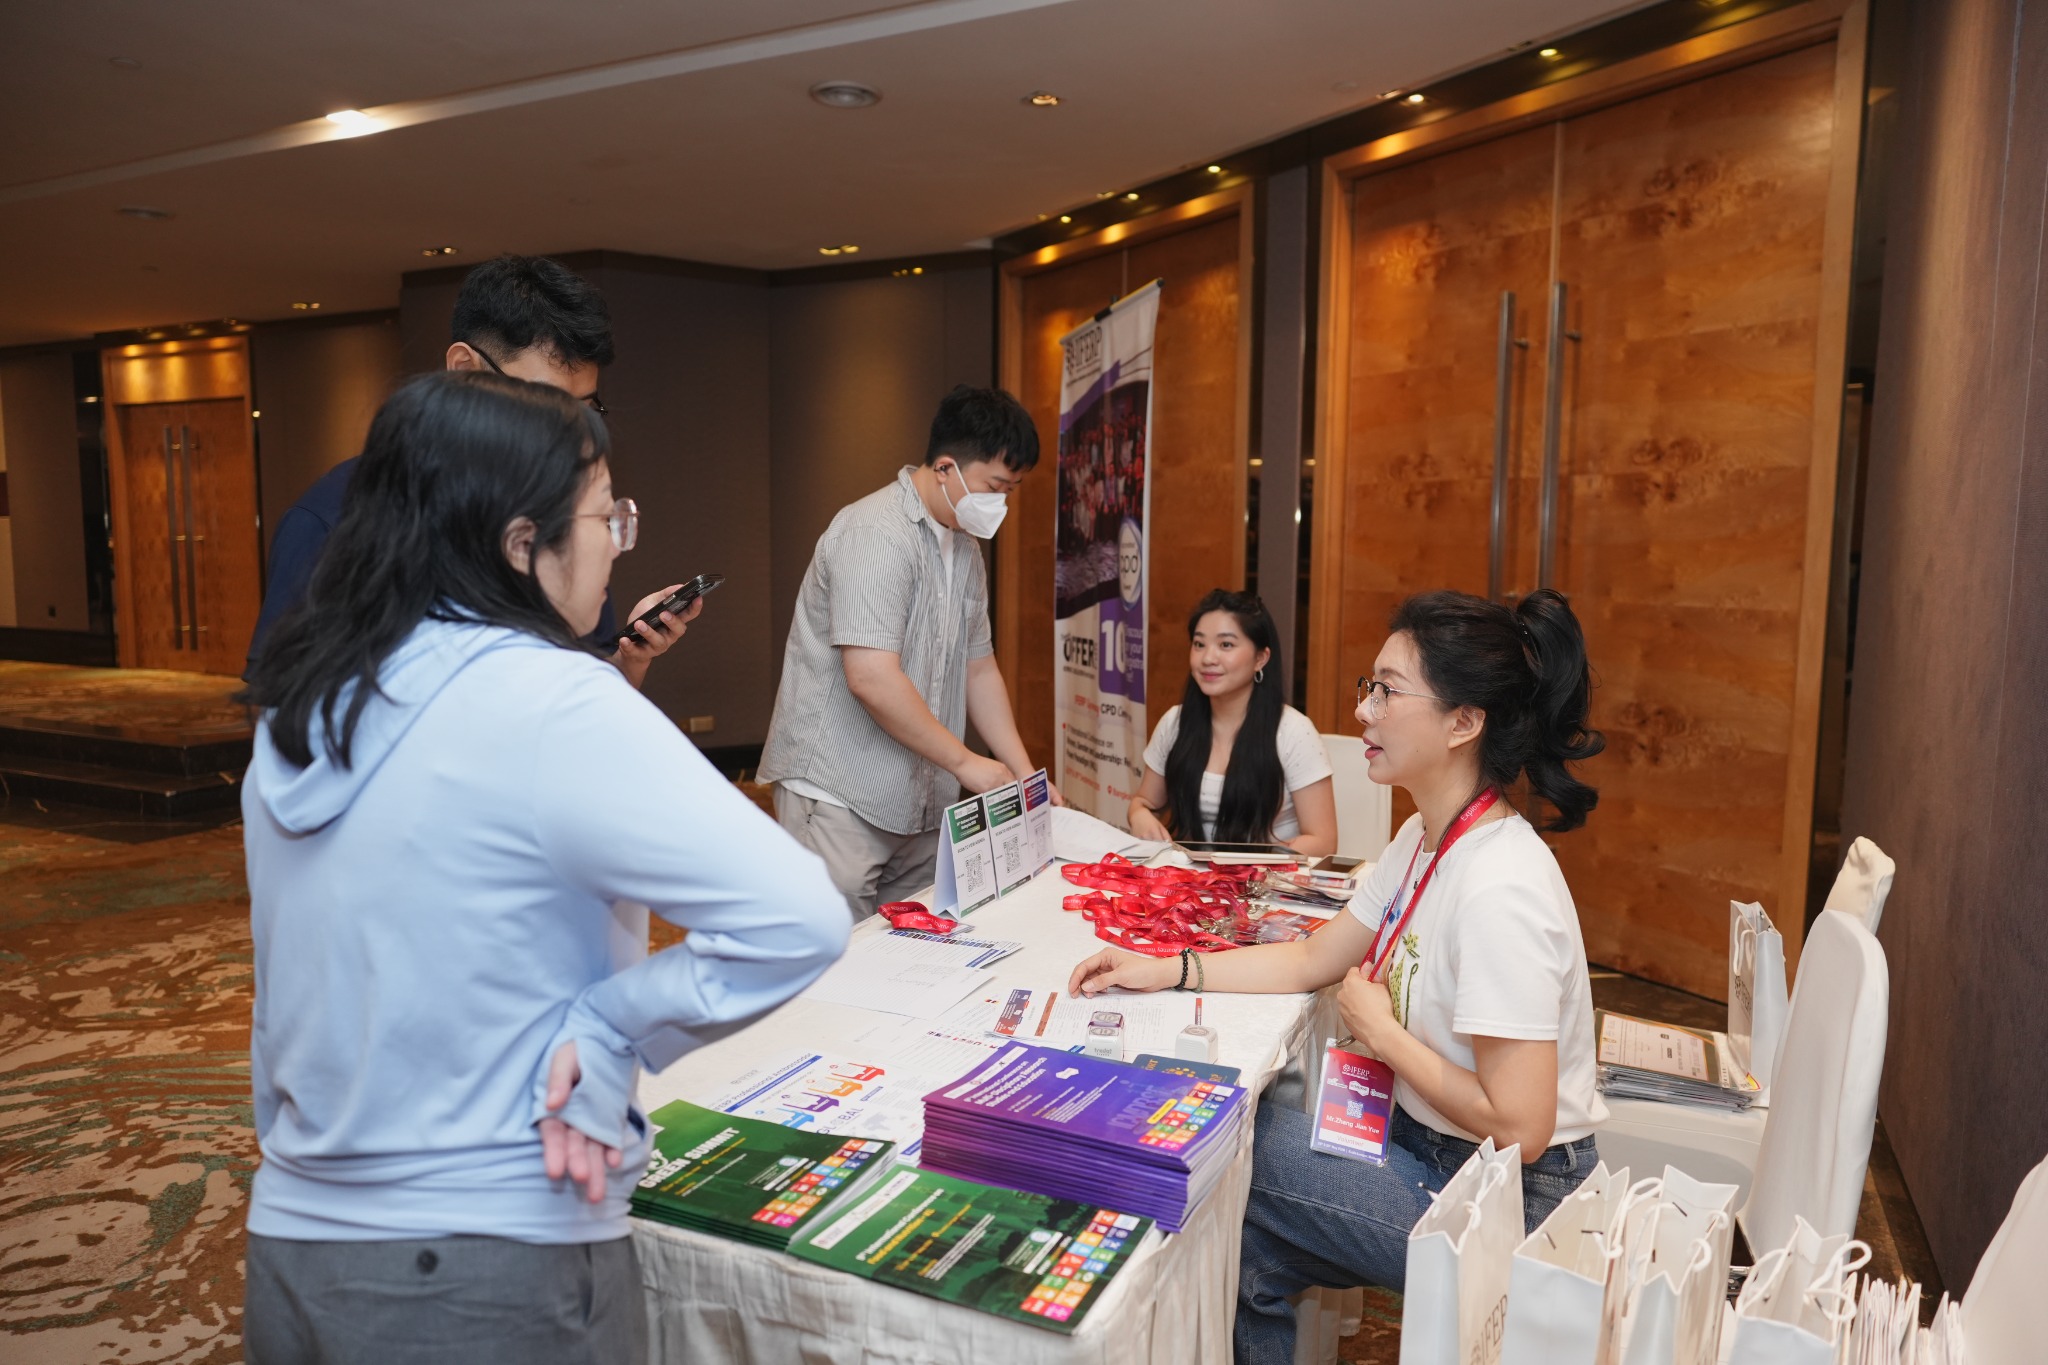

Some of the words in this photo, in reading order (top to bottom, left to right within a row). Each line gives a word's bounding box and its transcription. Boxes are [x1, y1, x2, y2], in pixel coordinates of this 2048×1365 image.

[1460, 801, 1482, 822] Explore
[1350, 1065, 1370, 1076] IFERP
[1368, 1125, 1380, 1134] Yue
[638, 1157, 691, 1188] GREEN
[684, 1127, 740, 1159] SUMMIT
